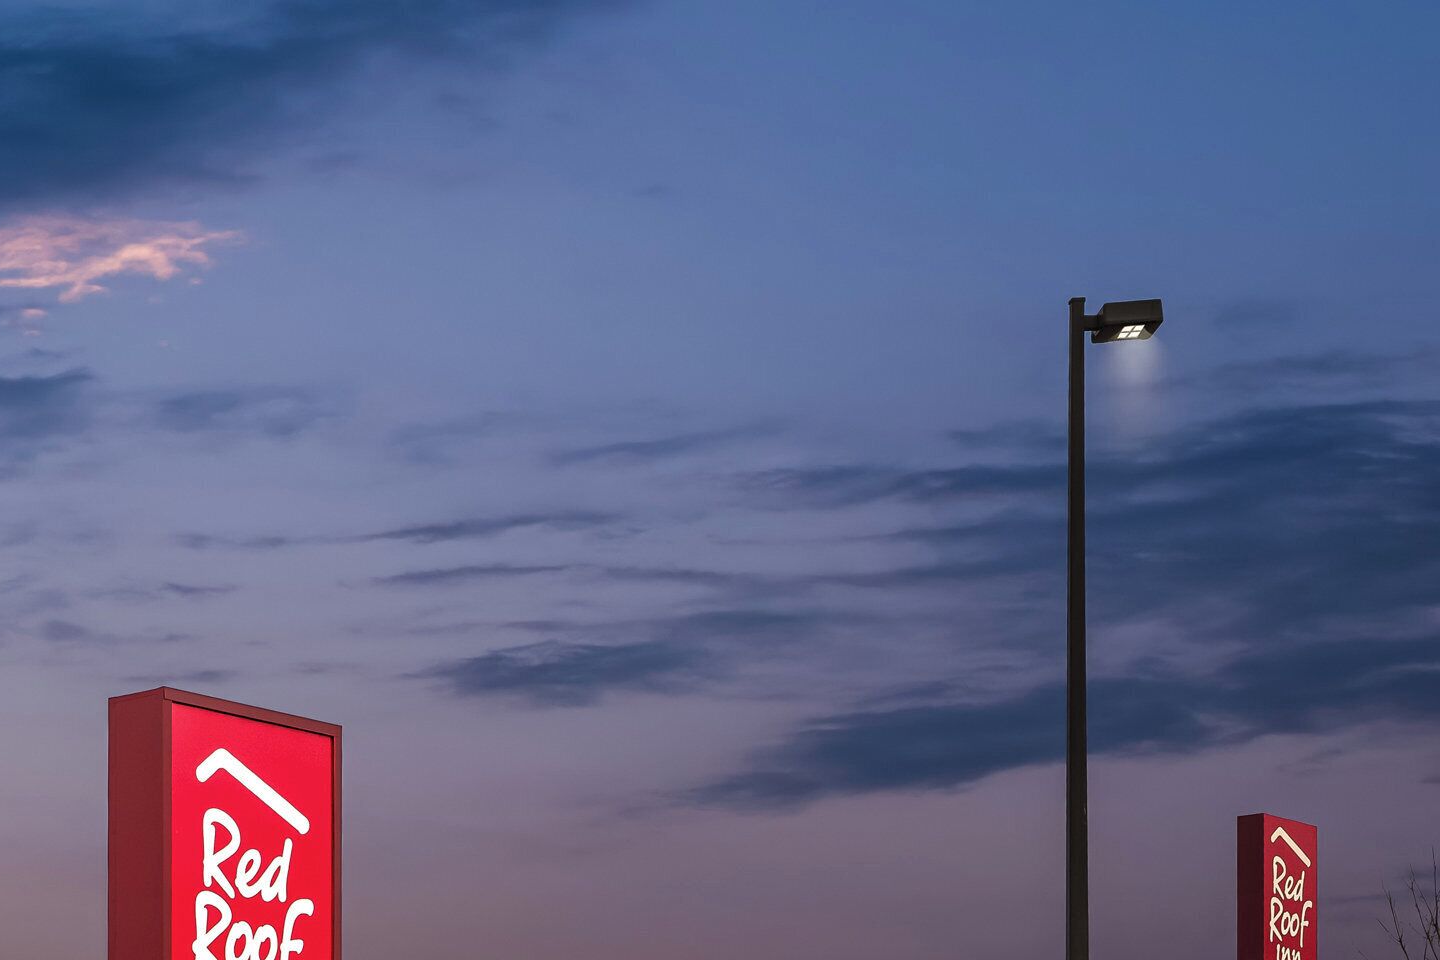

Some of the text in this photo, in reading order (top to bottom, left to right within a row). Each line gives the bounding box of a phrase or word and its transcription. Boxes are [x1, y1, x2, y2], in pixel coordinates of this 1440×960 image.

[202, 807, 293, 903] Red
[1272, 855, 1305, 902] Red
[1269, 896, 1313, 949] Roof
